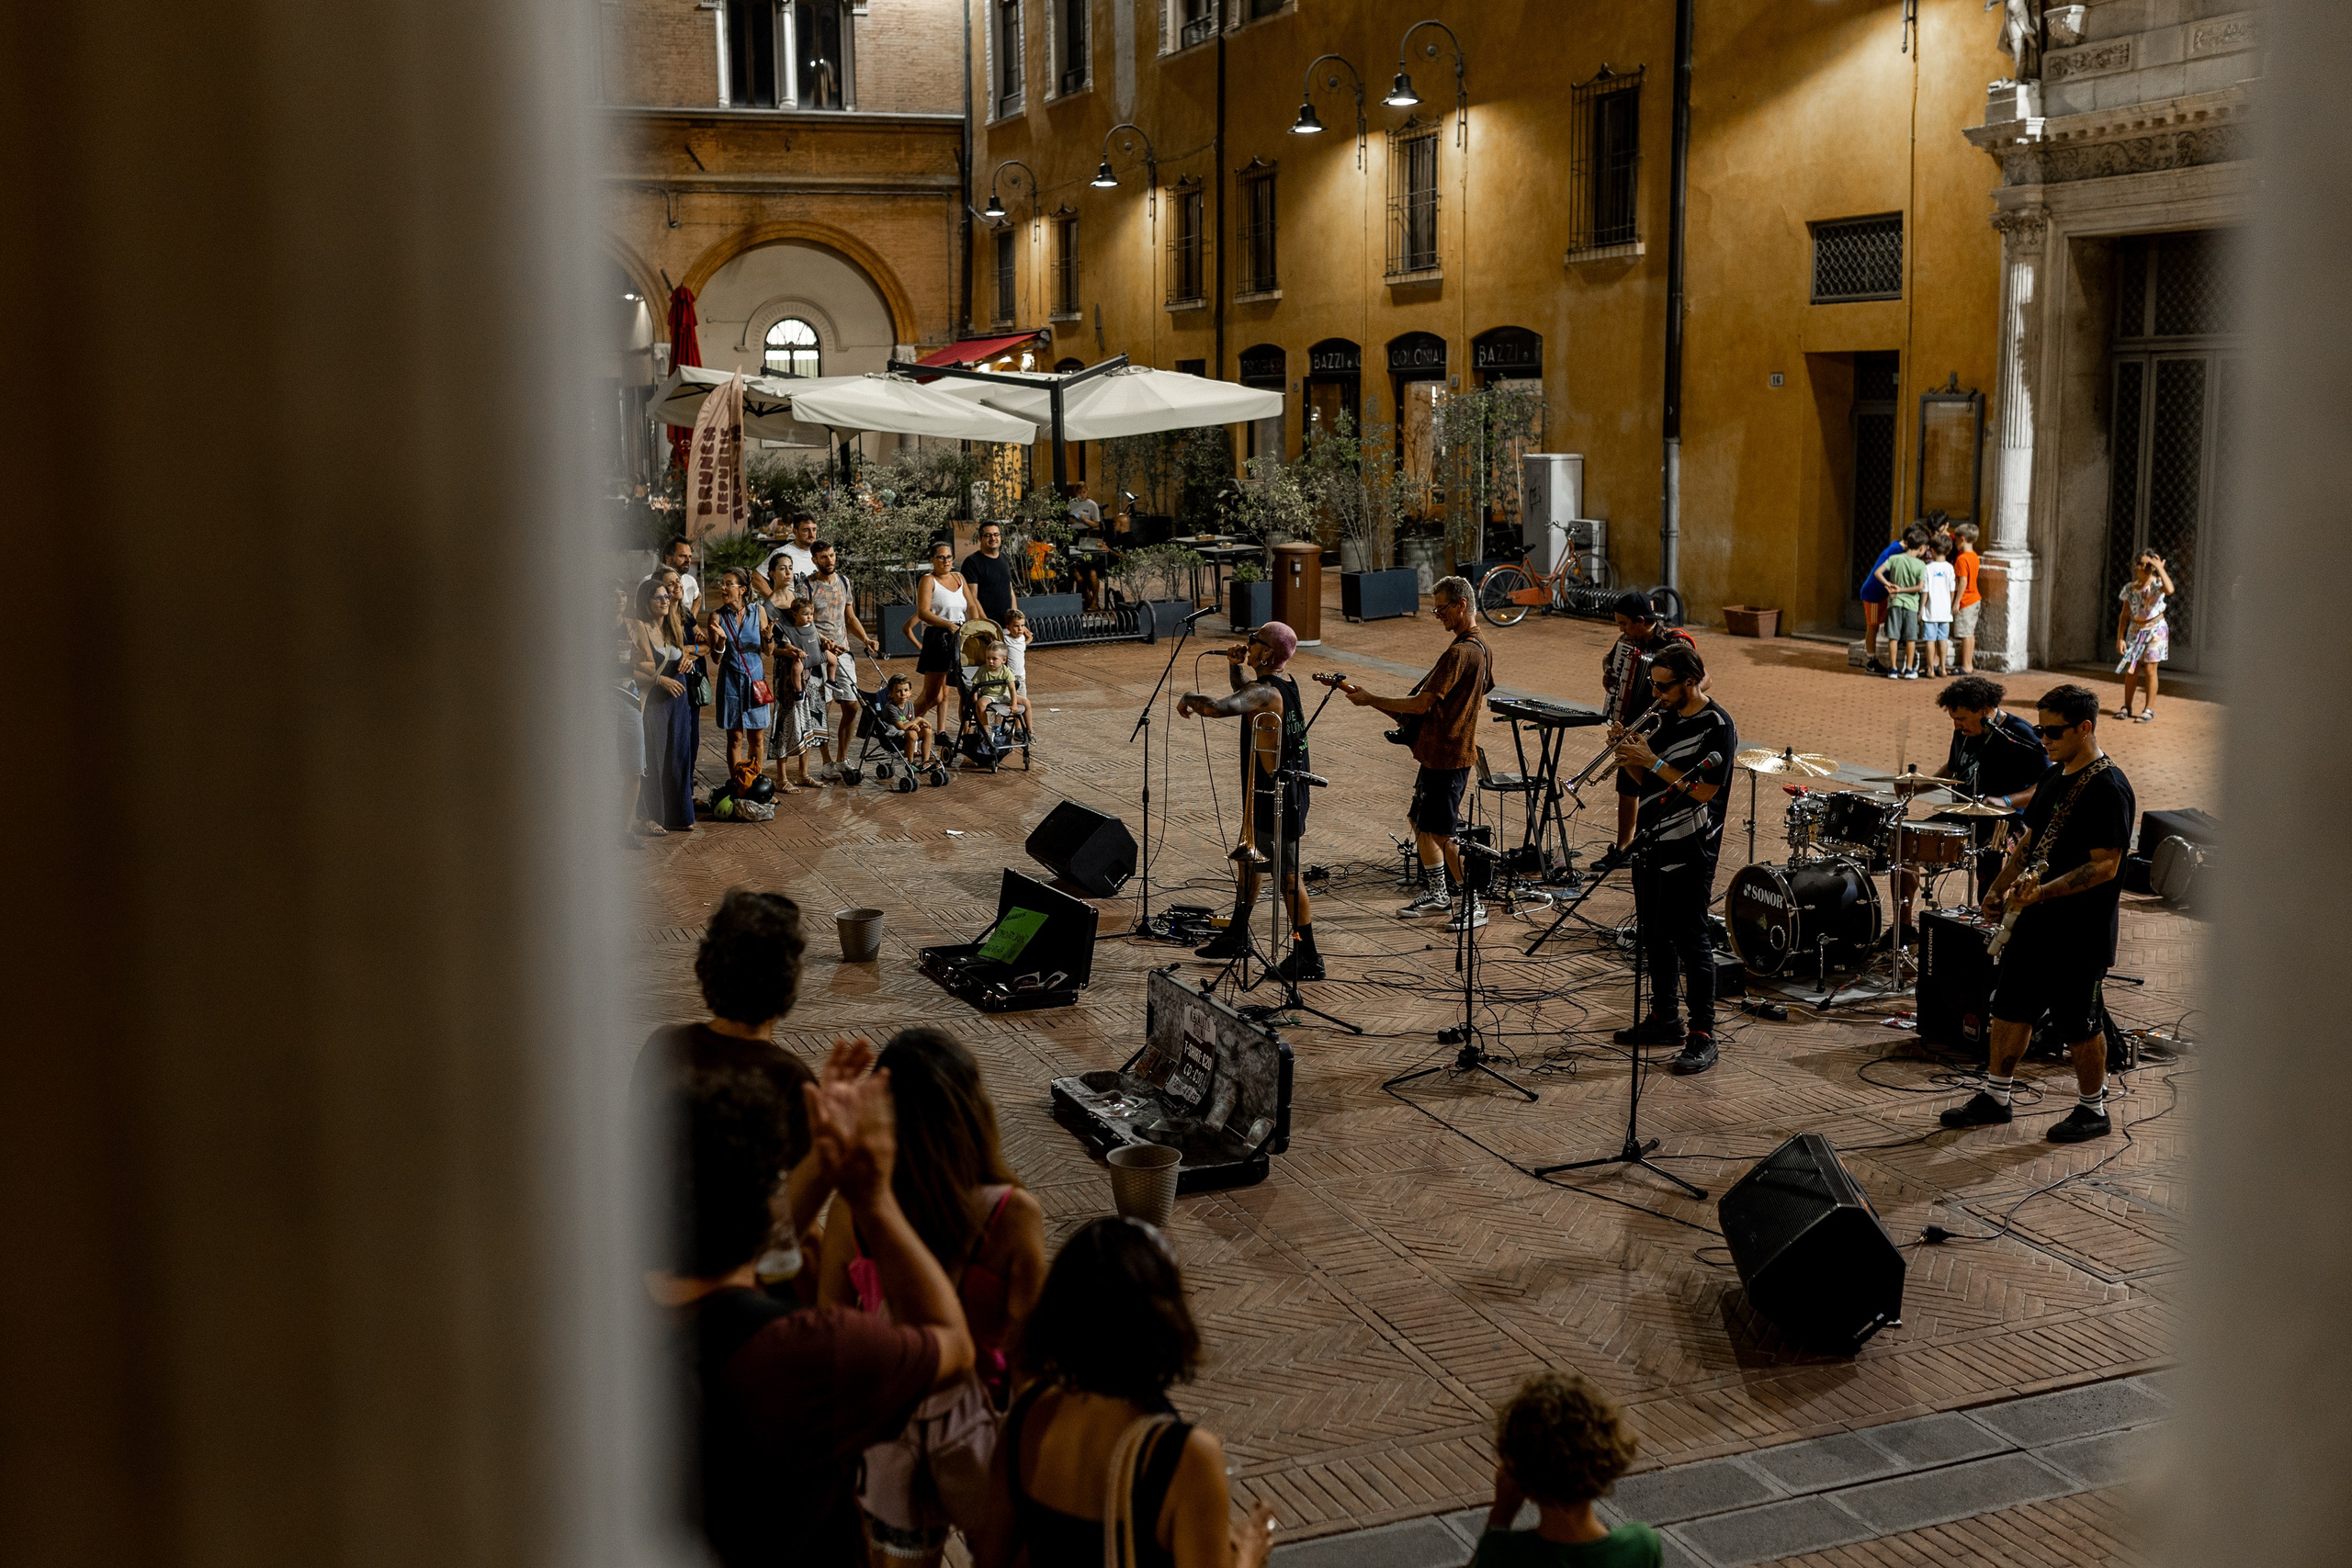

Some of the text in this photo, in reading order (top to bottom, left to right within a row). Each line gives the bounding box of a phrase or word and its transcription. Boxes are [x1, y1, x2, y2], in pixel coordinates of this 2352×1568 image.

[1314, 353, 1344, 369] BAZZI
[1479, 344, 1518, 363] BAZZI
[1772, 375, 1781, 384] 16
[697, 426, 717, 516] BRUNCH
[1751, 886, 1783, 909] SONOR
